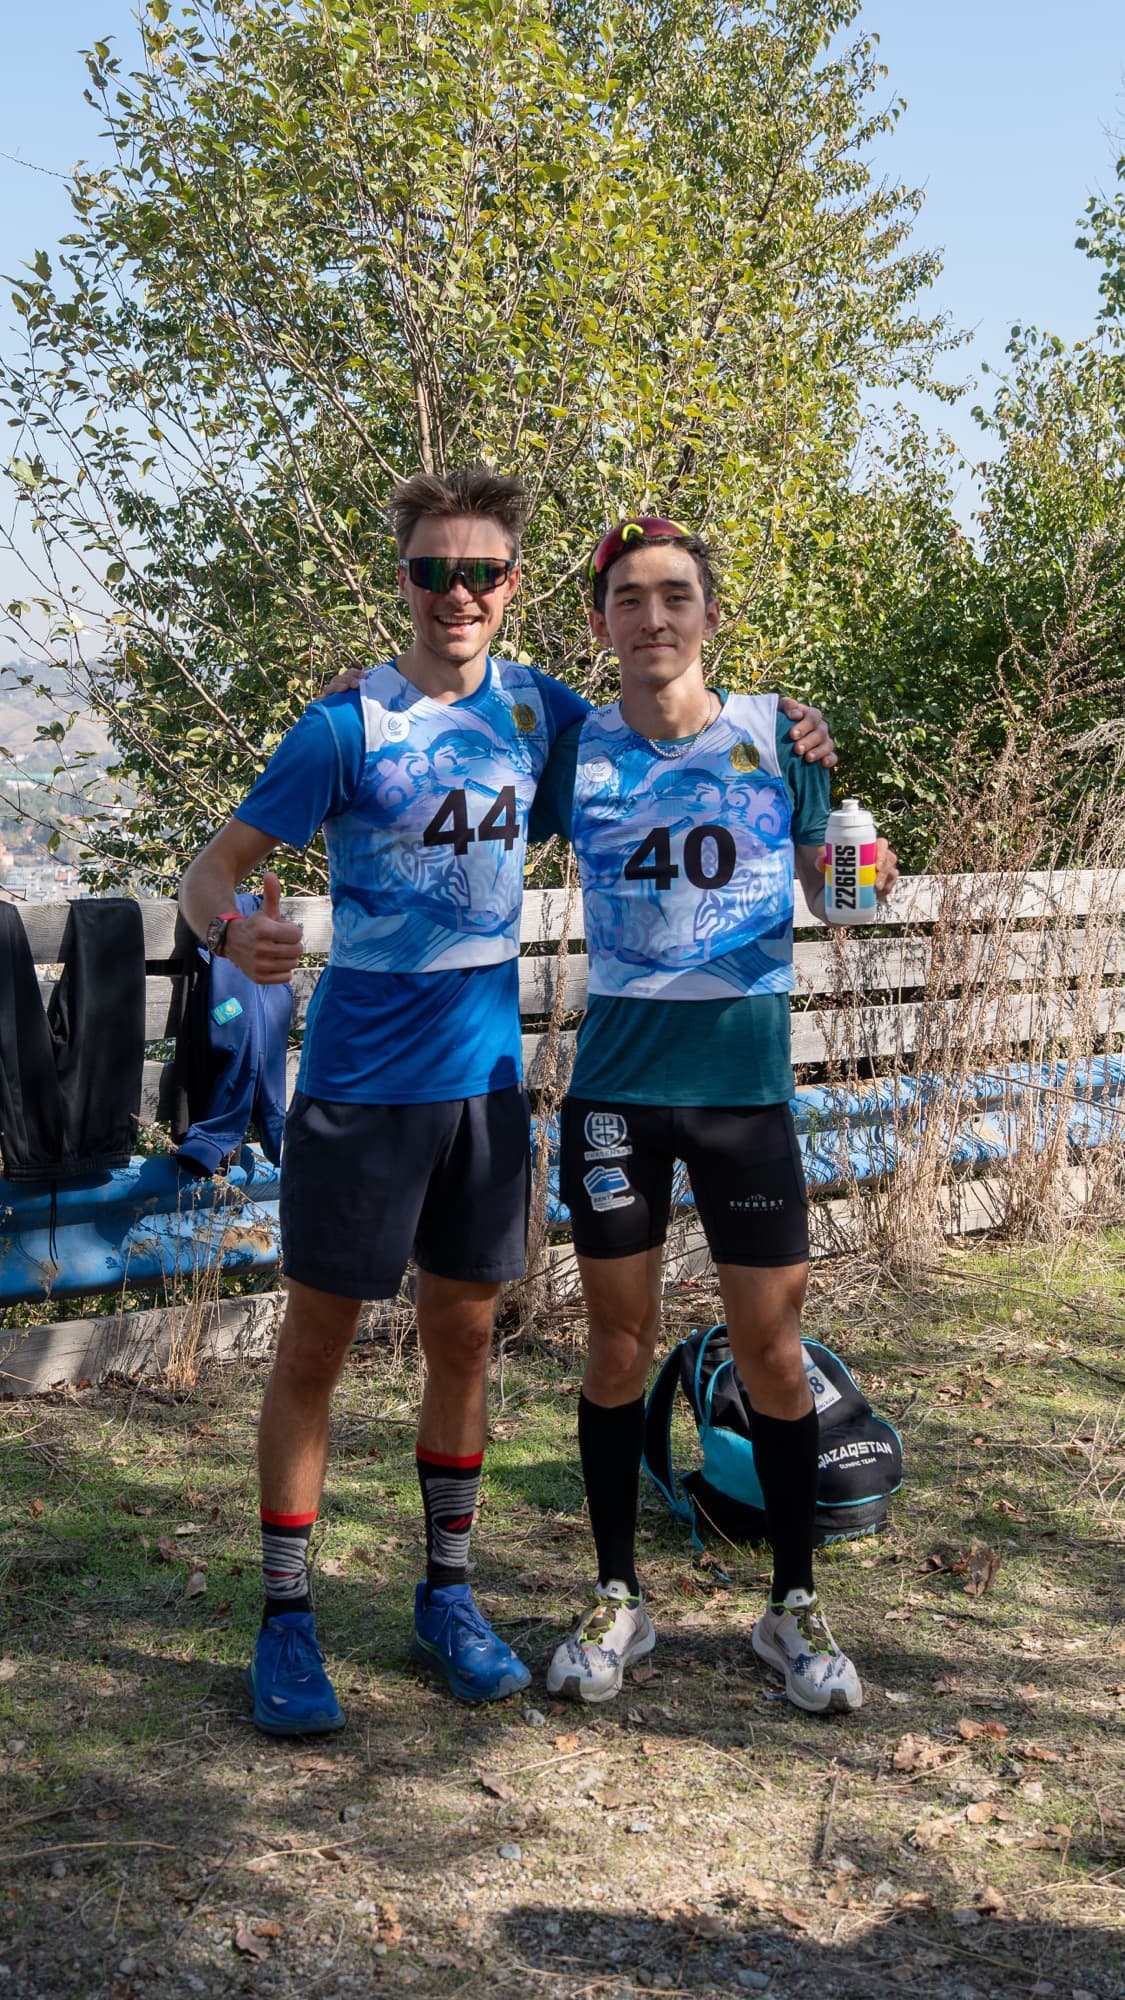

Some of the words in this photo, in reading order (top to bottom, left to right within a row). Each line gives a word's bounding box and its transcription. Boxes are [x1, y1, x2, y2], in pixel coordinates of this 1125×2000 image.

[423, 785, 520, 856] 44
[624, 825, 737, 890] 40
[835, 844, 857, 910] 226ERS
[729, 1199, 784, 1208] EVEREST
[839, 1460, 862, 1470] OLYMPIC
[860, 1456, 877, 1466] TEAM
